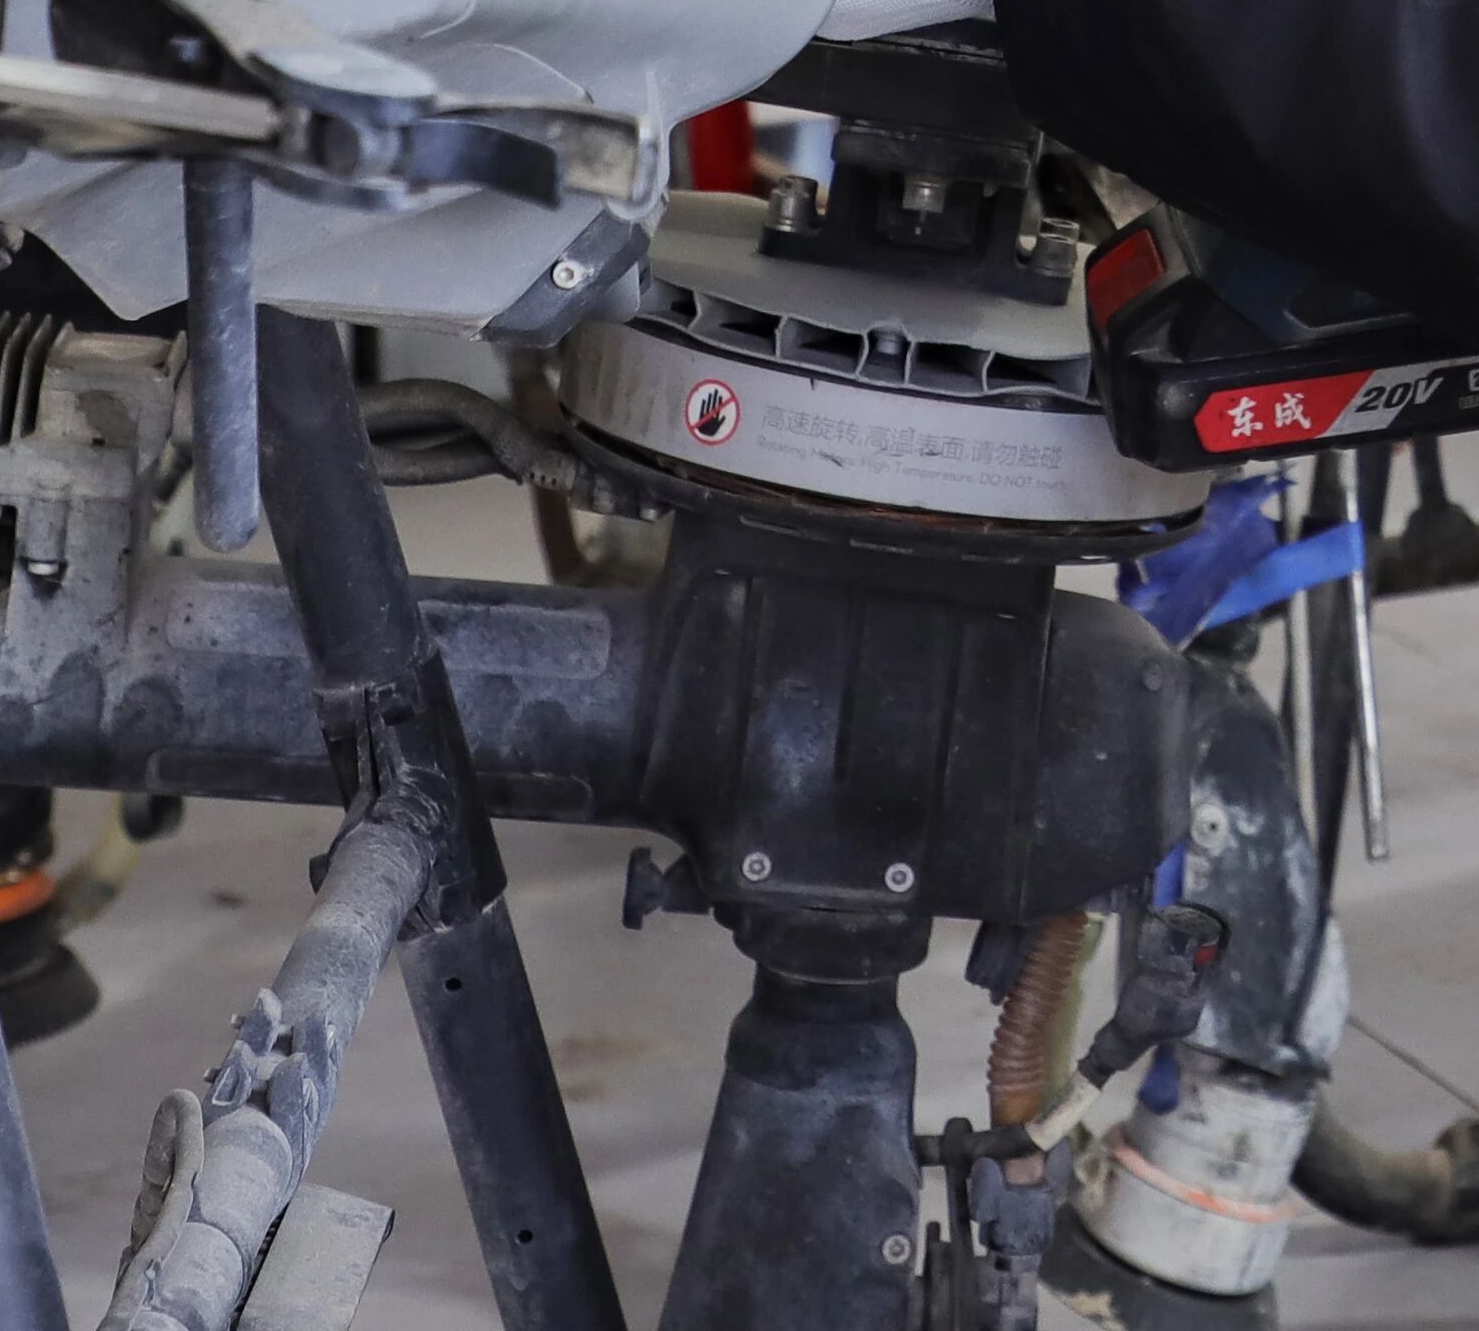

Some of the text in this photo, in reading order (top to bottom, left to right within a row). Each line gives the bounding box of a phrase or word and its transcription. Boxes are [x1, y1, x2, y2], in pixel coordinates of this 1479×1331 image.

[1355, 375, 1445, 414] 20V
[1227, 392, 1311, 437] 东成
[860, 456, 890, 475] High
[980, 472, 1001, 487] DO
[1004, 475, 1033, 488] NOT
